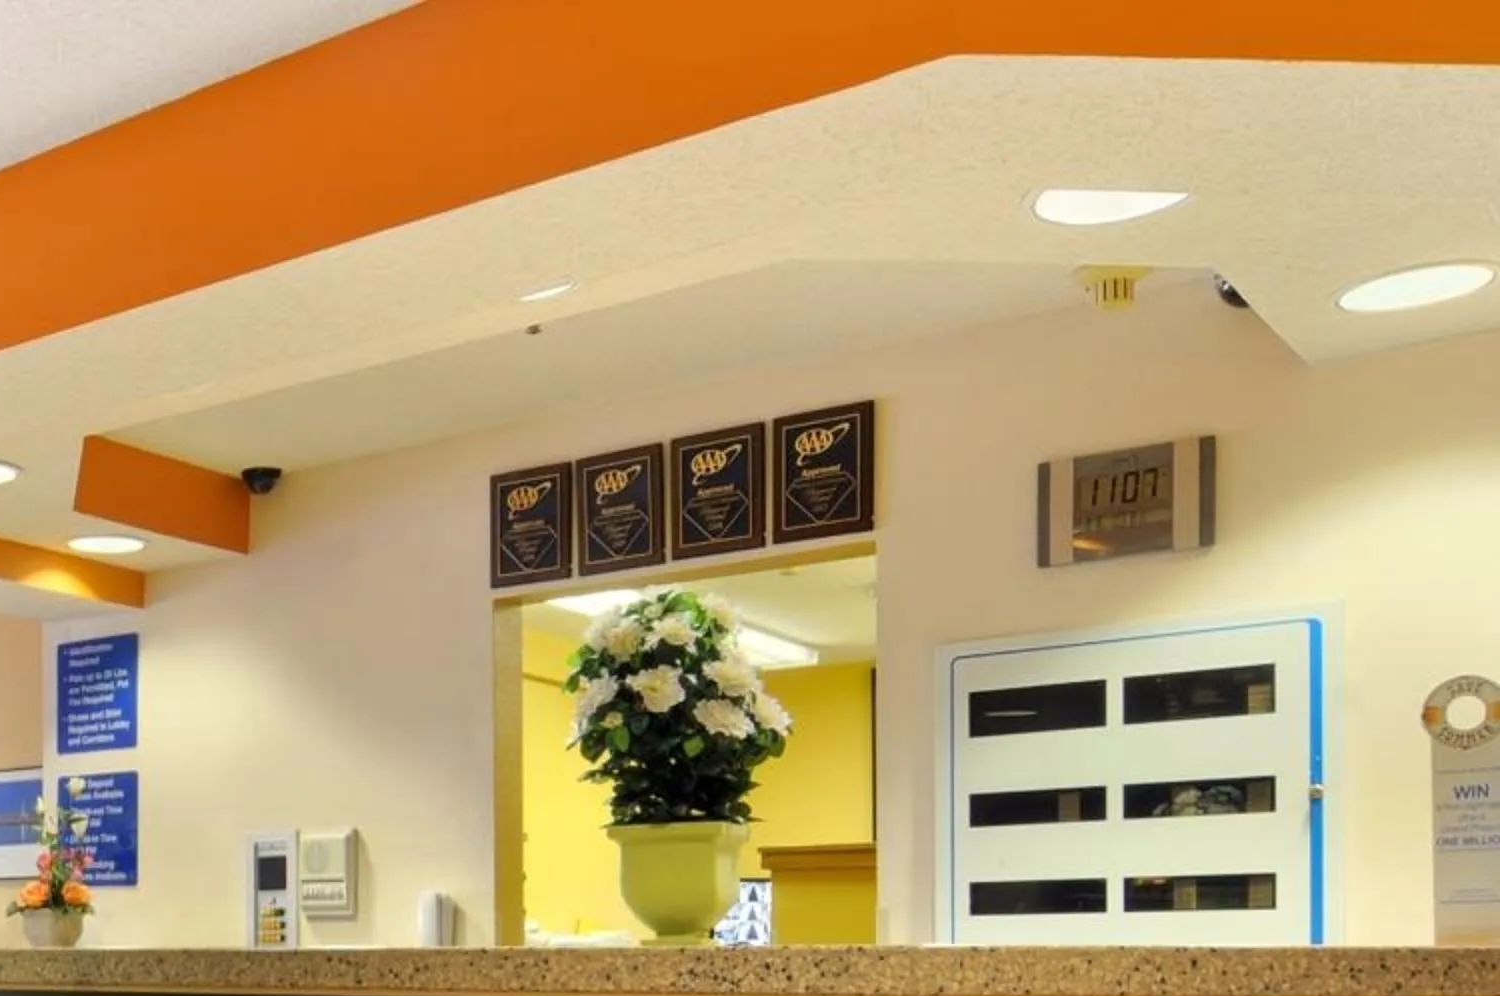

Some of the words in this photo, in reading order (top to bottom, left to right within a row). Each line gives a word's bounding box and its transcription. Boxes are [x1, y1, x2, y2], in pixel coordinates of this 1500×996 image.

[796, 429, 833, 454] AAA
[692, 450, 726, 475] AAA
[596, 469, 628, 494] AAA
[509, 486, 538, 510] AAA
[1453, 783, 1490, 800] WIN
